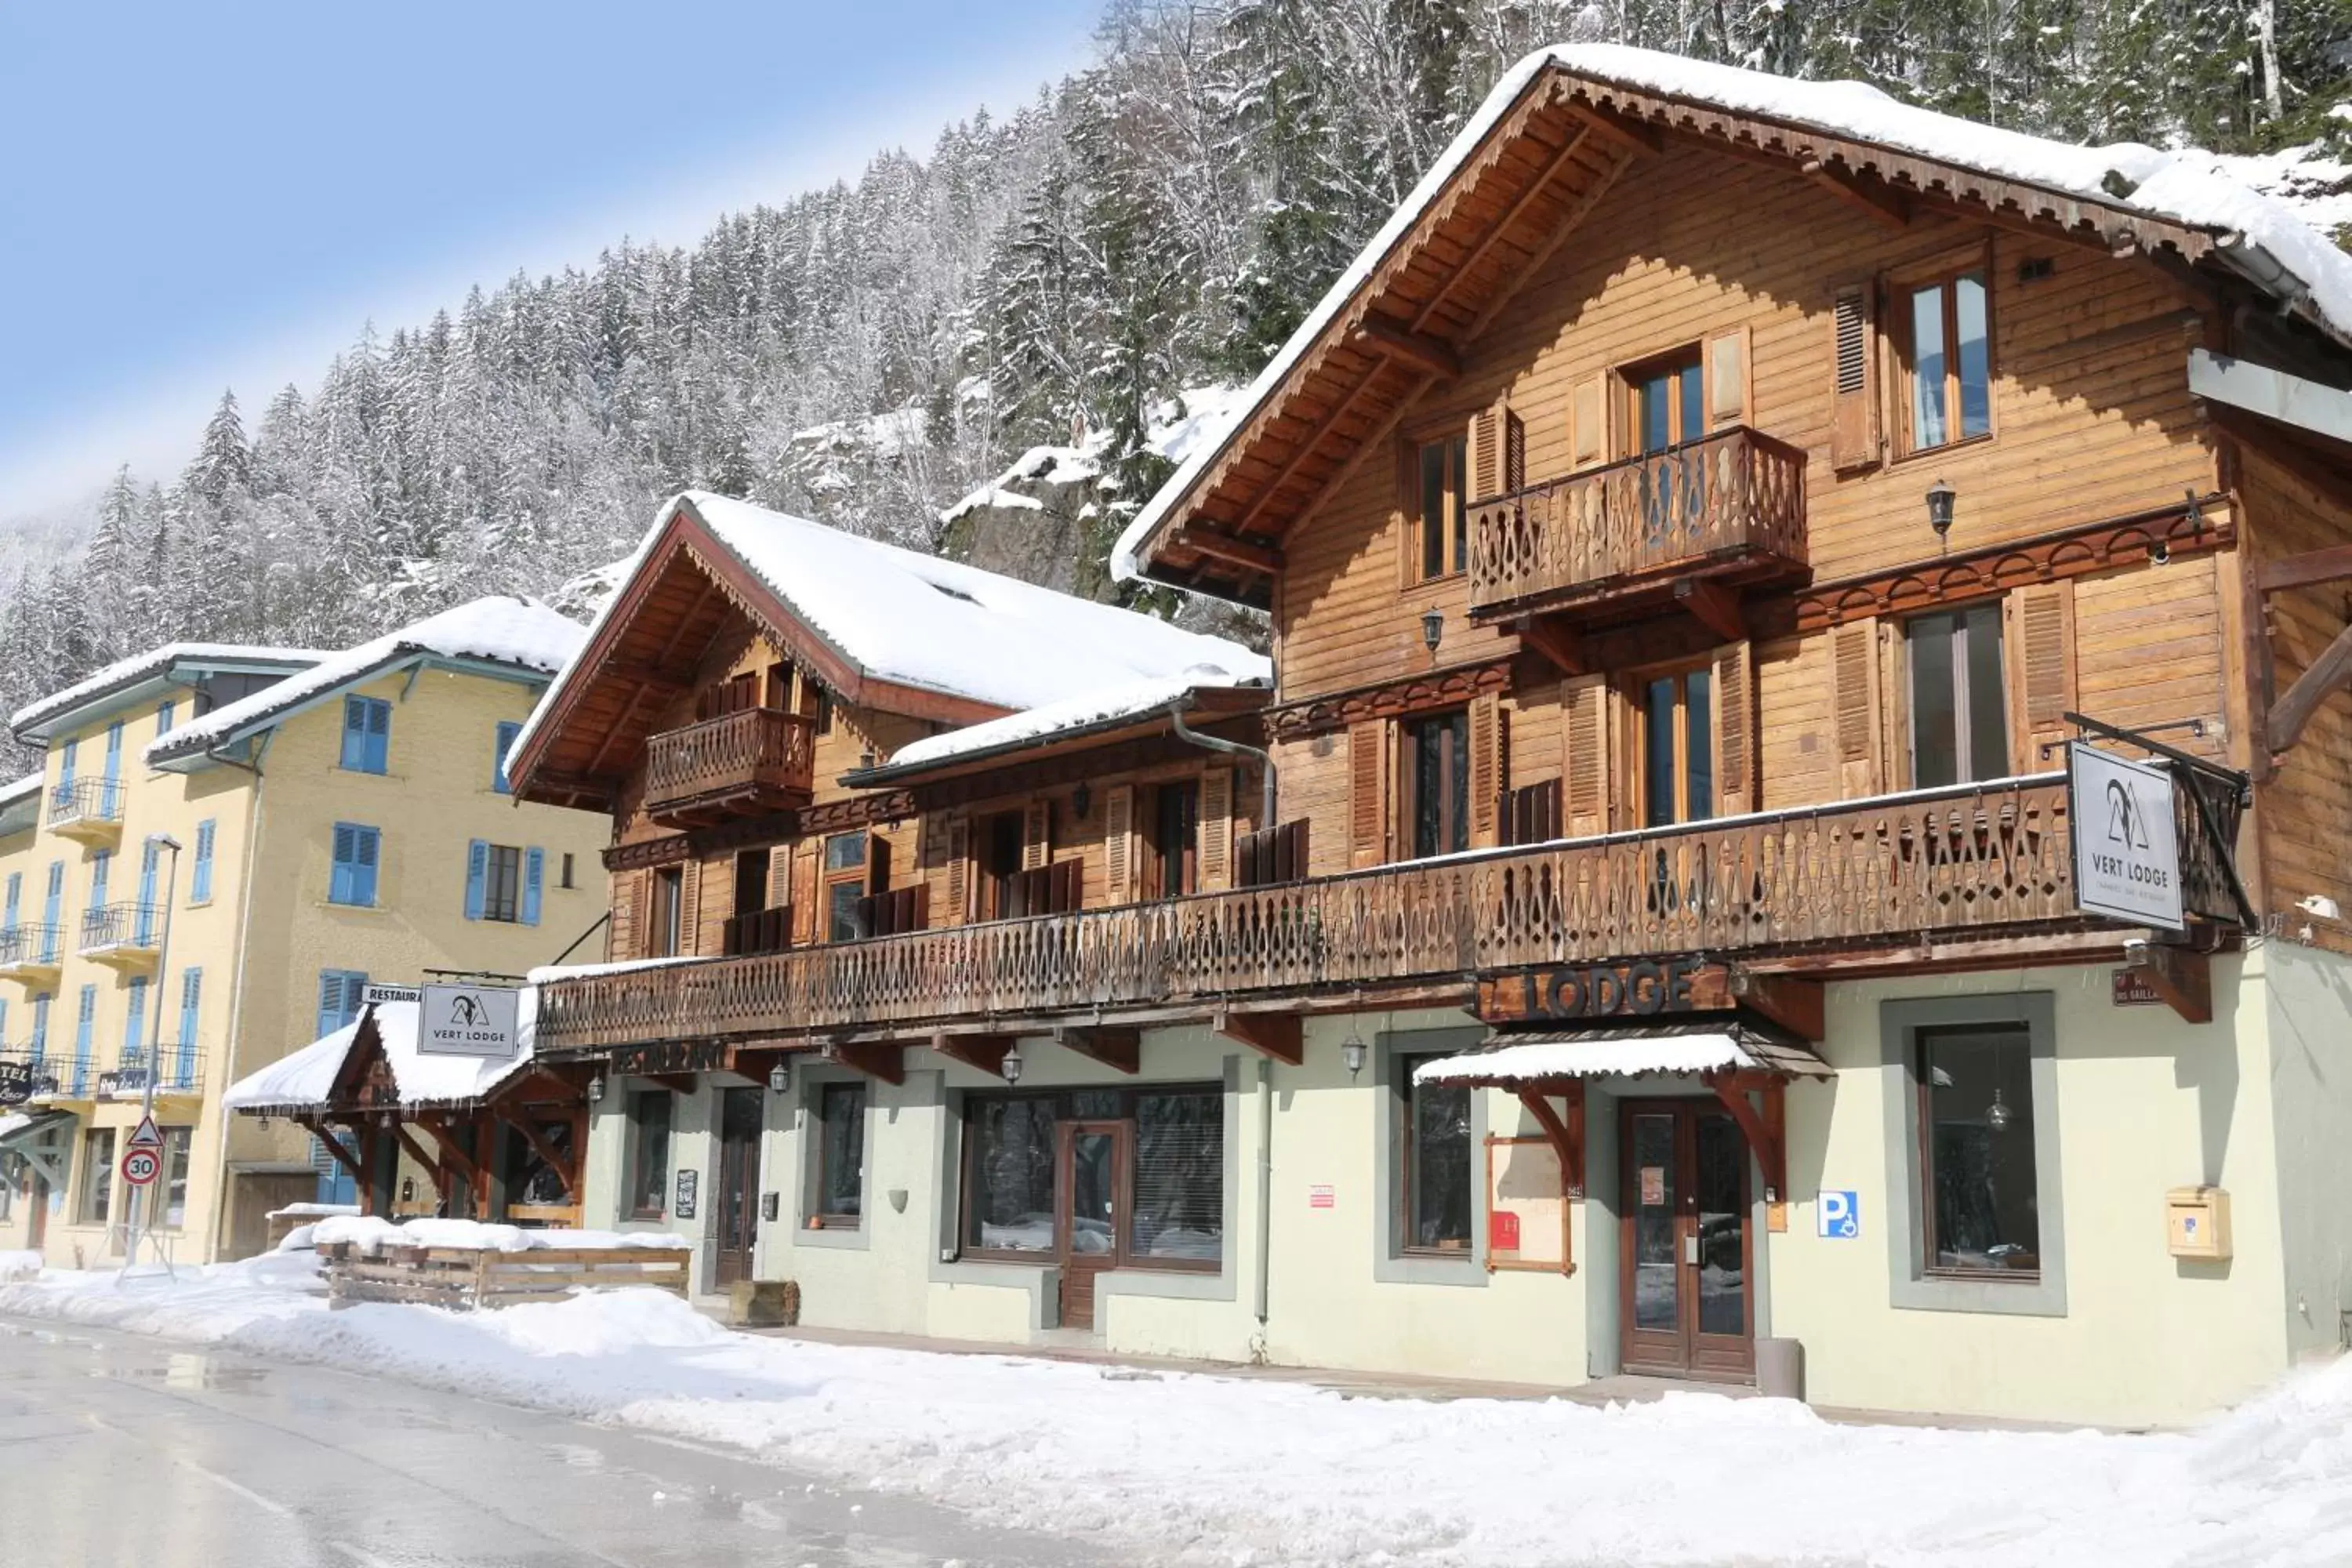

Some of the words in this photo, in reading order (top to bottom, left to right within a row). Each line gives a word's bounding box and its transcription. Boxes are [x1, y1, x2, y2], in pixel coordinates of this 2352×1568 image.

[2092, 852, 2122, 877] VERT
[2128, 861, 2169, 889] LODGE
[1525, 961, 1693, 1018] LODGE
[434, 1029, 462, 1040] VERT
[466, 1031, 506, 1042] LODGE
[130, 1160, 153, 1174] 30
[1819, 1192, 1849, 1236] P
